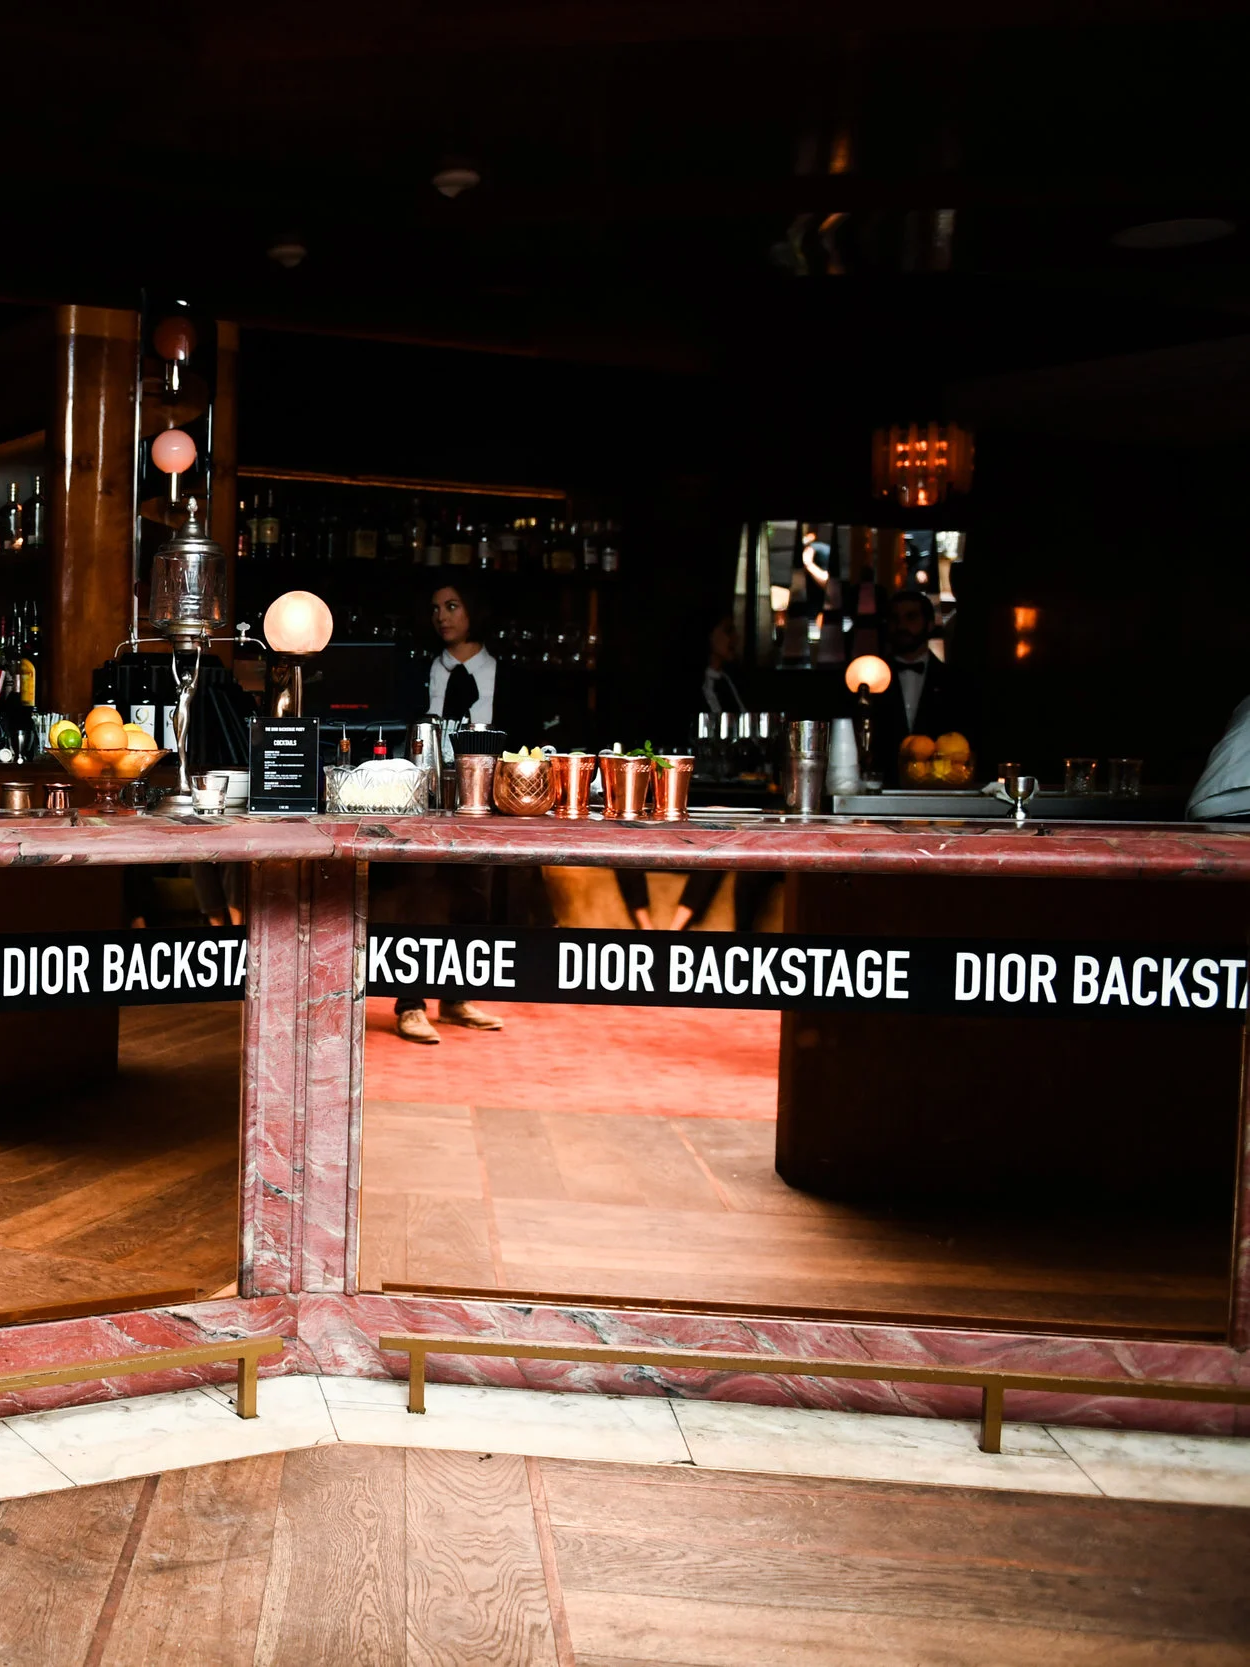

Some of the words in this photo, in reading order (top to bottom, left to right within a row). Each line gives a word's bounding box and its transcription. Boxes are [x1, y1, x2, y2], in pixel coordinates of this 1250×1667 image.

[4, 945, 90, 997] DIOR
[368, 936, 517, 987] KSTAGE
[556, 943, 655, 992] DIOR
[669, 945, 910, 999] BACKSTAGE
[954, 952, 1057, 1004] DIOR
